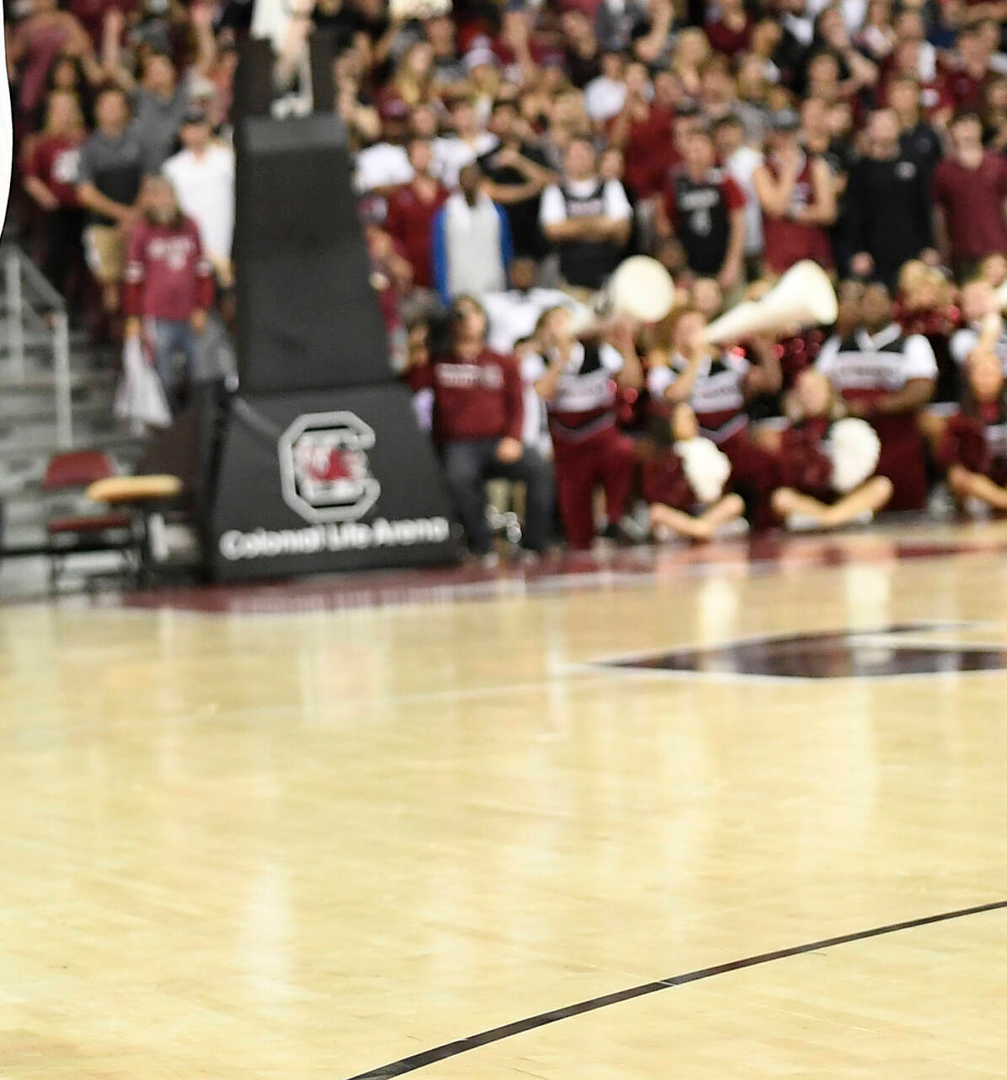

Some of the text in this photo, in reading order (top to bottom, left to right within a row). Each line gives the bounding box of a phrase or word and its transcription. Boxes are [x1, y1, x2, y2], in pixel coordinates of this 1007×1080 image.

[219, 517, 451, 560] Colonial Life Arena
